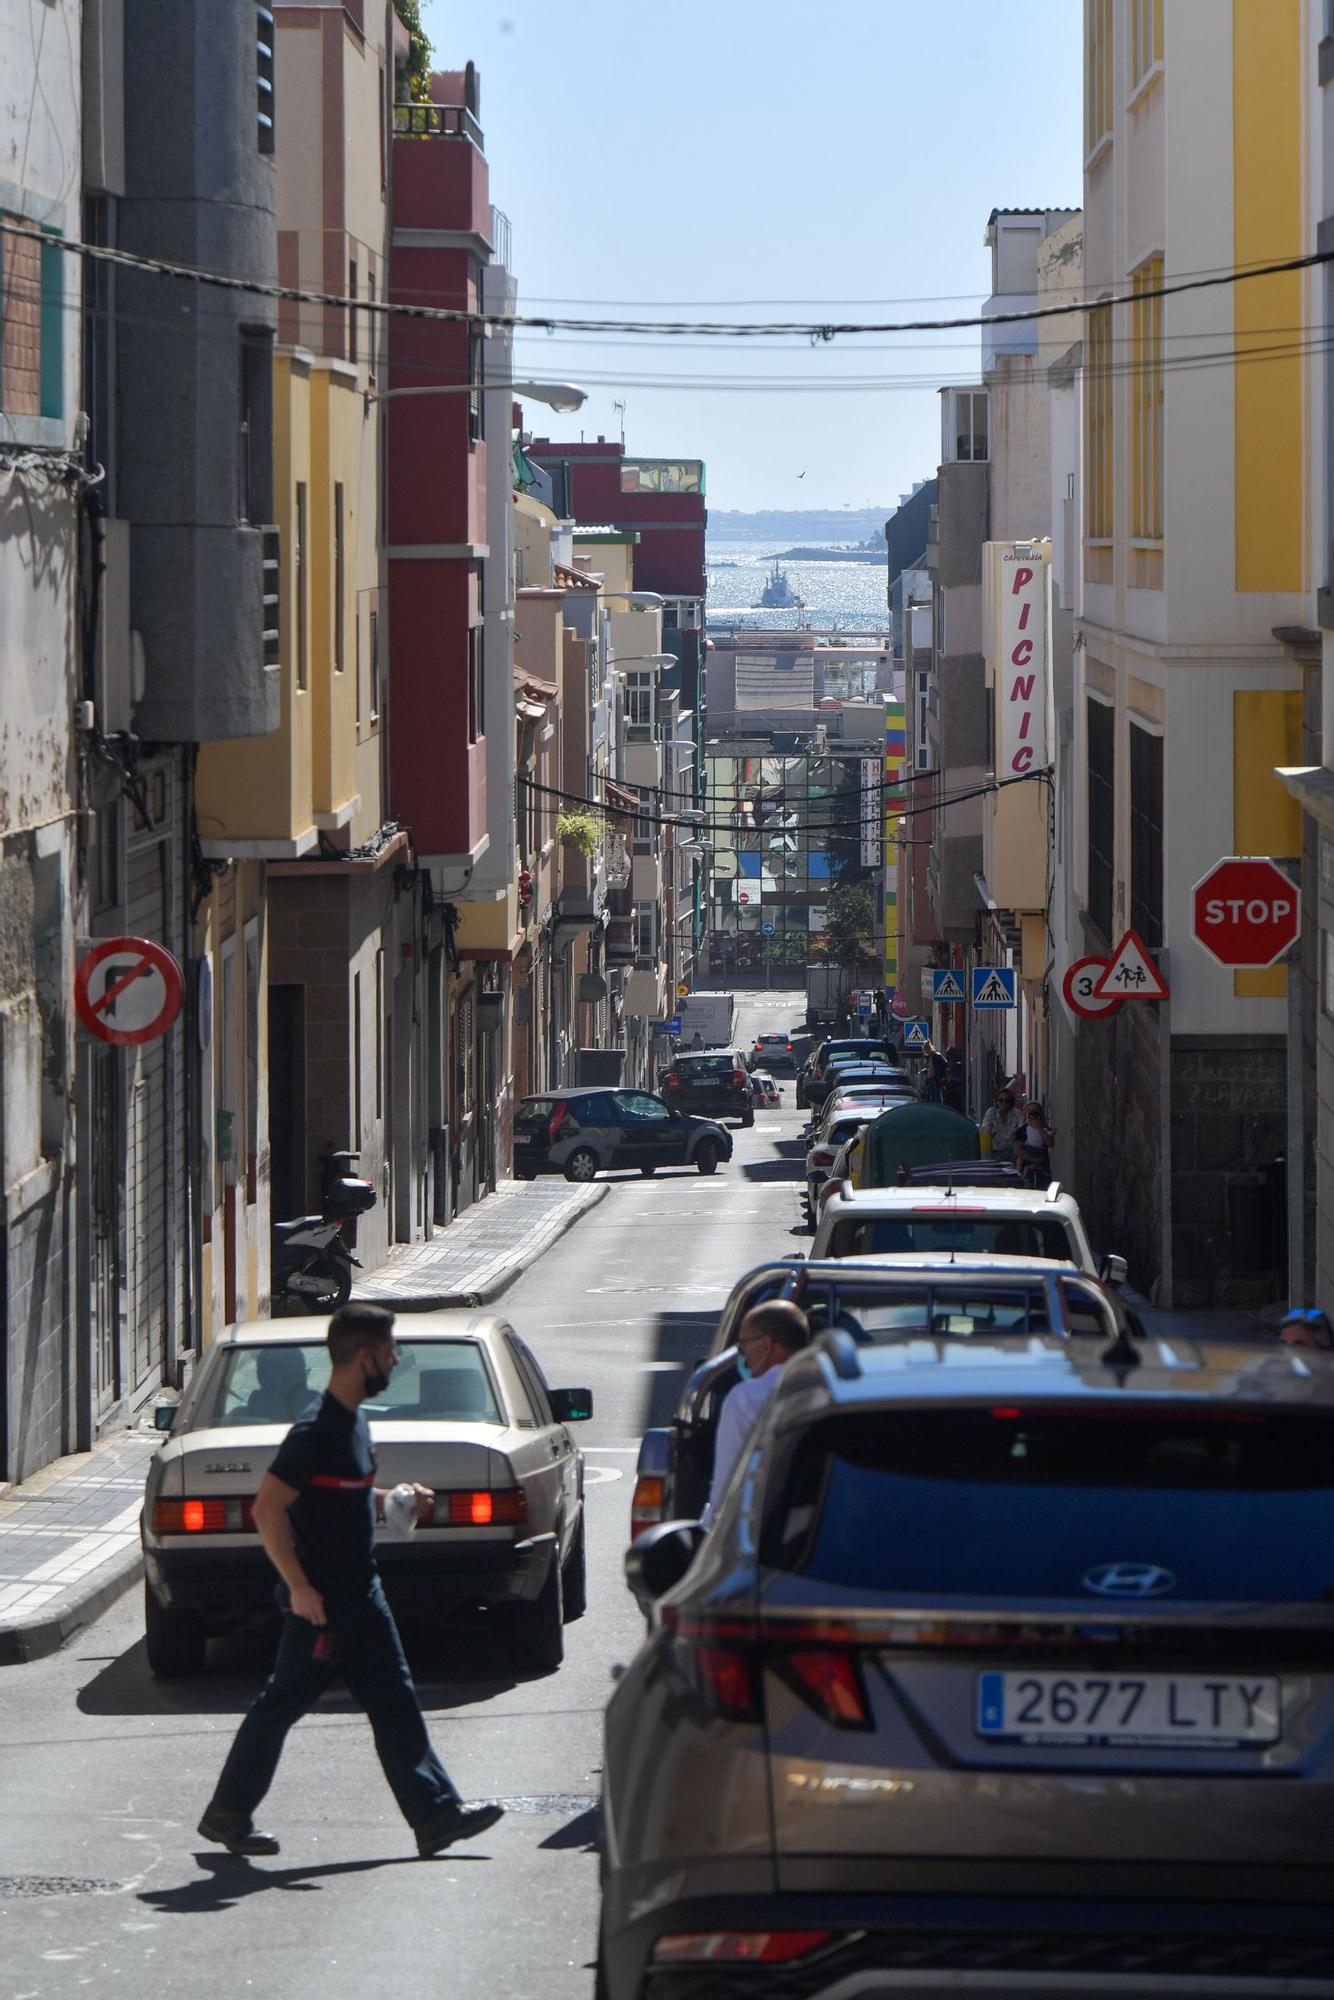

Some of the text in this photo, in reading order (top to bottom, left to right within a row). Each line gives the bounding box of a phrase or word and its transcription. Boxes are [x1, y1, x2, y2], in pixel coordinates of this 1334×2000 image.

[1010, 567, 1036, 773] PICNIC
[1204, 899, 1291, 925] STOP
[1078, 977, 1093, 997] 3
[1016, 1679, 1265, 1729] 2677 LTY
